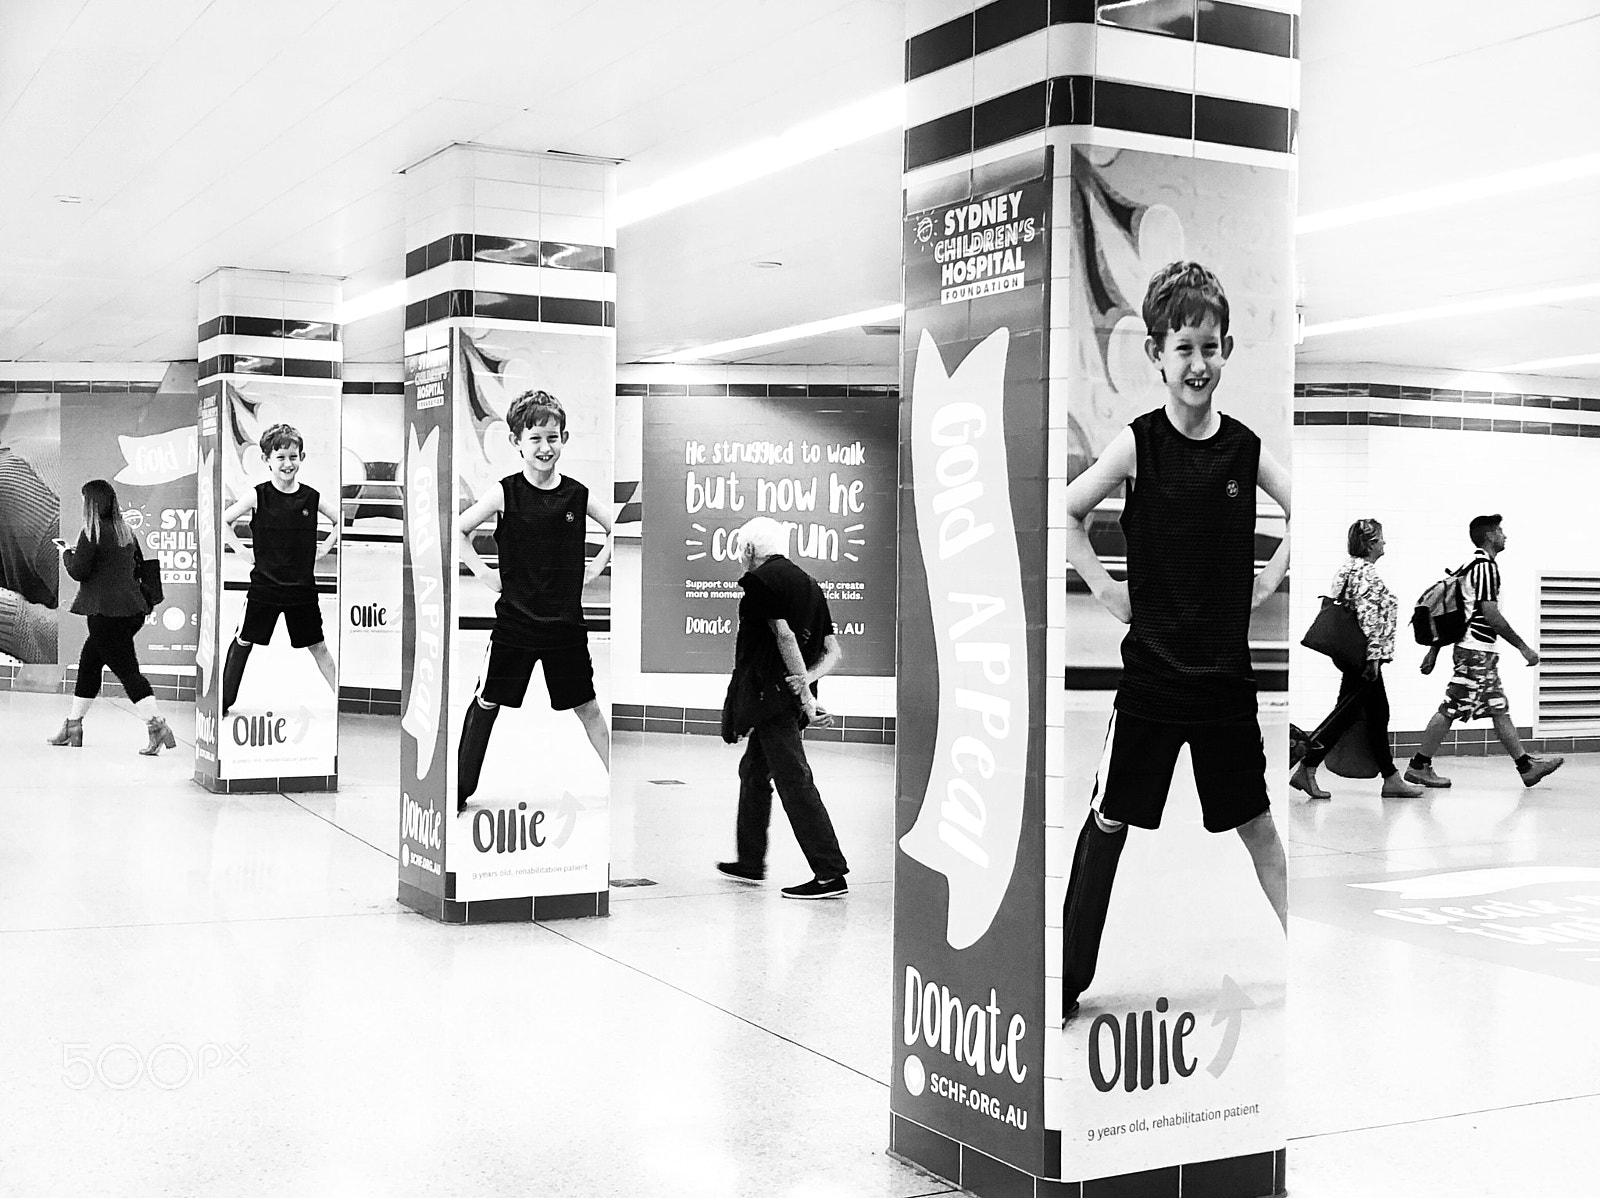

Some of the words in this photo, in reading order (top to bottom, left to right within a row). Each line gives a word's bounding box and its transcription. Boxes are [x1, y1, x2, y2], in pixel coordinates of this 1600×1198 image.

[944, 190, 1023, 236] SYDNEY
[934, 217, 1035, 264] CHILDREN'S
[941, 247, 1026, 287] HOSPITAL
[945, 276, 1019, 300] FOUNDATION
[685, 440, 706, 465] He
[712, 440, 794, 465] struggled
[801, 440, 820, 464] to
[827, 441, 865, 466] walk
[685, 470, 746, 514] but
[756, 476, 818, 513] now
[829, 472, 865, 516] he
[929, 401, 995, 561] Gold
[160, 508, 198, 530] SY
[685, 579, 722, 590] Support
[817, 580, 835, 591] elp
[836, 582, 865, 590] create
[841, 590, 864, 600] kids.
[350, 602, 387, 628] Ollie
[685, 616, 732, 635] Donate
[233, 711, 287, 747] Ollie
[402, 792, 442, 850] Donate
[473, 801, 547, 854] Ollie
[904, 965, 1027, 1084] Donate
[1088, 996, 1198, 1093] Ollie
[930, 1072, 1028, 1131] SCHF.ORG.AU
[1087, 1129, 1095, 1141] 9
[1098, 1124, 1127, 1142] years
[1129, 1119, 1150, 1132] old,
[1152, 1108, 1221, 1129] rehabilitation
[1223, 1103, 1260, 1121] patient
